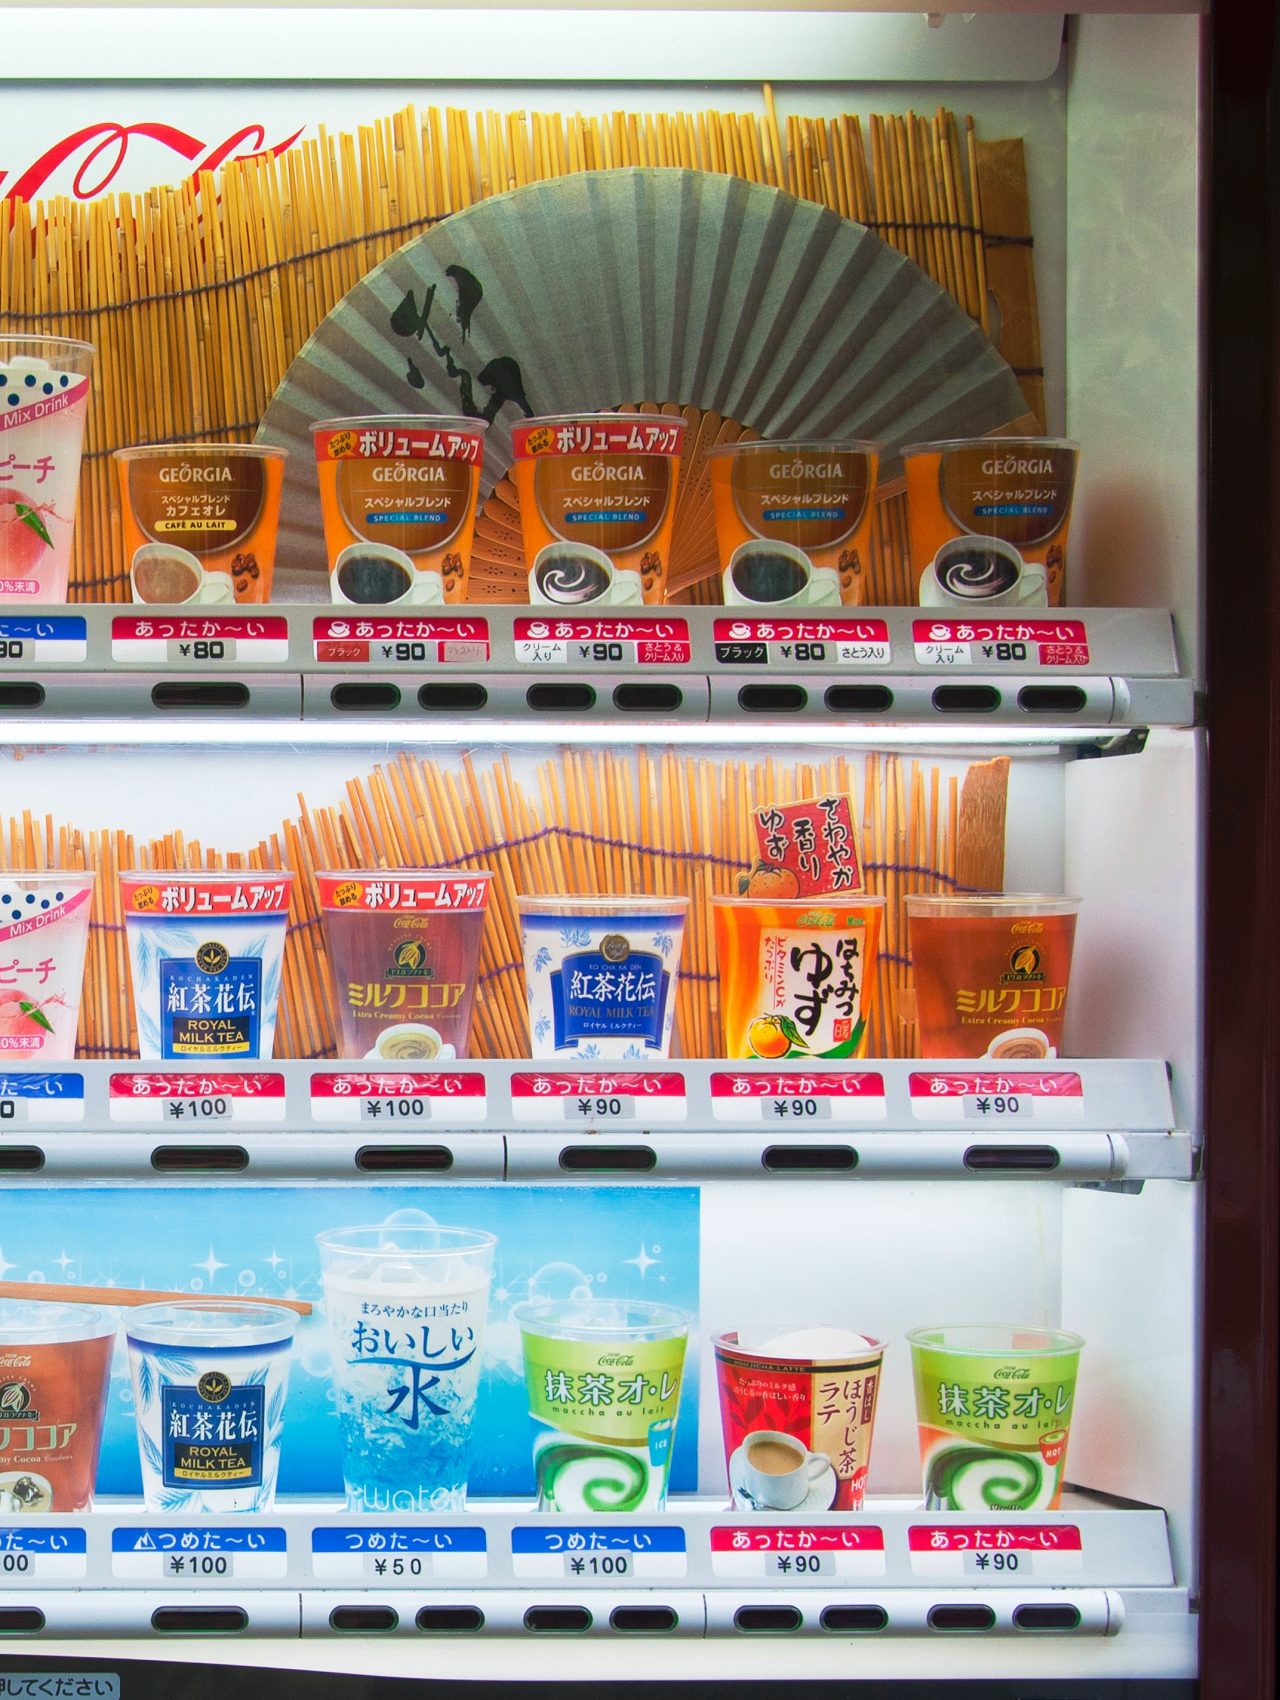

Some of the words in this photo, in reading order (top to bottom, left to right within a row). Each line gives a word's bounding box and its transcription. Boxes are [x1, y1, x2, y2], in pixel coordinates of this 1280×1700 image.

[4, 411, 30, 428] Mix
[35, 393, 68, 416] Drink
[360, 431, 481, 460] ボリュームアップ
[161, 495, 231, 504] スペシャルブレンド
[166, 505, 226, 517] カフェオレ
[374, 514, 409, 522] SPECIAL
[414, 514, 441, 522] BLEND
[165, 520, 187, 529] CAFÉ
[191, 521, 202, 529] AU
[206, 521, 226, 529] LAIT
[179, 641, 224, 659] ¥80
[381, 642, 425, 660] ¥90
[580, 644, 622, 660] ¥90
[721, 646, 764, 658] ブラック
[780, 643, 826, 661] ¥80
[842, 647, 884, 659] さとう入り
[982, 644, 1026, 660] ¥80
[759, 810, 788, 860] ゆず
[819, 799, 852, 887] さわやか
[794, 820, 819, 879] 香り
[162, 884, 284, 912] ボリュームアップ
[835, 939, 859, 1016] はちみつ
[168, 981, 256, 1013] 紅茶花伝
[348, 983, 465, 1008] ミルクココア
[791, 943, 834, 1035] ゆず
[188, 1020, 236, 1030] ROYAL
[179, 1032, 214, 1043] MILK
[217, 1032, 243, 1042] TEA
[169, 1098, 226, 1118] ¥100
[367, 1100, 424, 1116] ¥100
[578, 1099, 621, 1115] ¥90
[774, 1099, 817, 1116] ¥90
[976, 1097, 1019, 1114] ¥90
[361, 1302, 468, 1318] まろやかな口当たり
[352, 1321, 474, 1358] おいしい
[545, 1370, 677, 1405] 抹茶オ・レ
[385, 1365, 450, 1430] 水
[817, 1382, 840, 1424] ラテ
[553, 1407, 605, 1416] maccha
[643, 1407, 664, 1415] lait
[169, 1409, 257, 1441] 紅茶花伝
[839, 1380, 861, 1473] ほうじ茶
[170, 1556, 227, 1573] ¥100
[375, 1558, 421, 1575] ¥50
[571, 1557, 627, 1574] ¥100
[777, 1554, 821, 1573] ¥90
[976, 1553, 1018, 1570] ¥90
